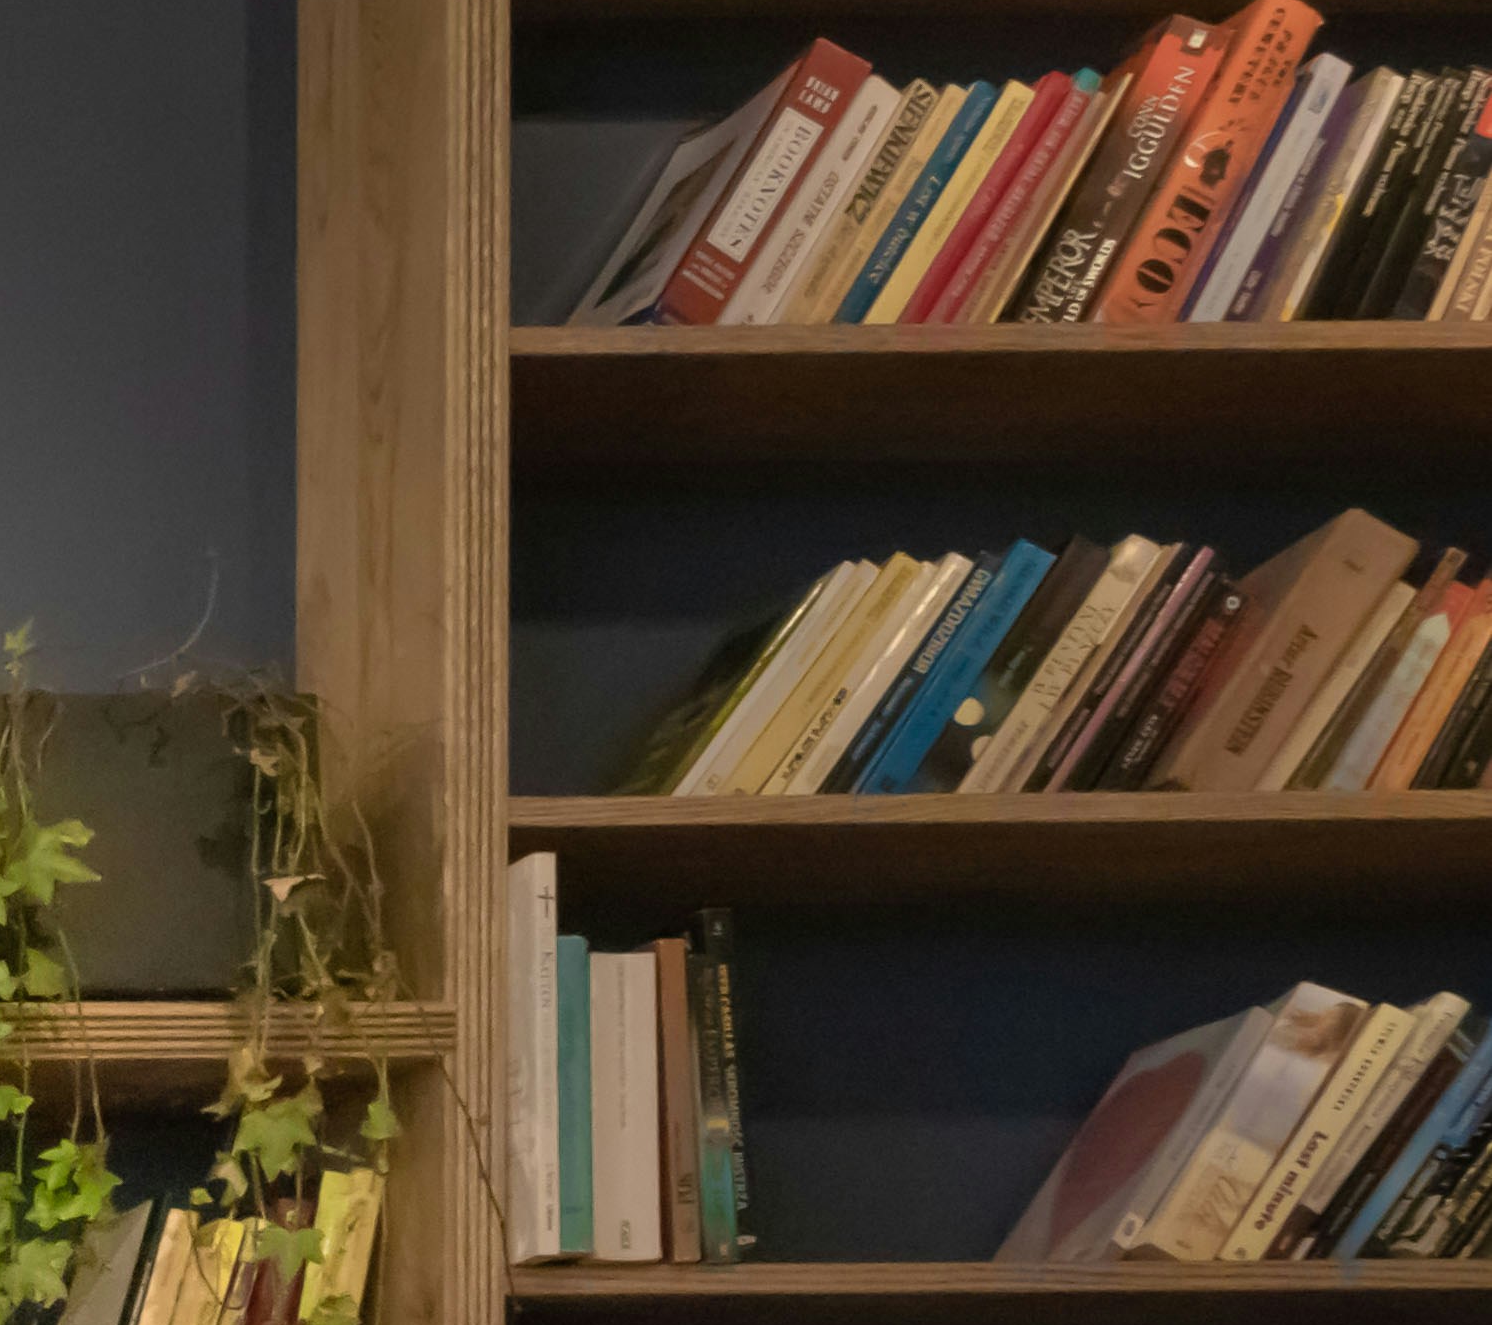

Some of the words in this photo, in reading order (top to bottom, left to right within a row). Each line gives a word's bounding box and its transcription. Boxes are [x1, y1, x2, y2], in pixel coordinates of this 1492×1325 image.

[836, 84, 945, 225] SIENKIEWICZ
[1113, 61, 1207, 183] IGGULDEN
[723, 122, 816, 254] BOOKNOTES
[799, 168, 843, 228] OSTATNI
[756, 225, 809, 299] SZCZEGÓŁ
[1219, 662, 1296, 760] RUBINSTEIN
[1292, 1127, 1330, 1172] Last
[1248, 1166, 1304, 1235] minute
